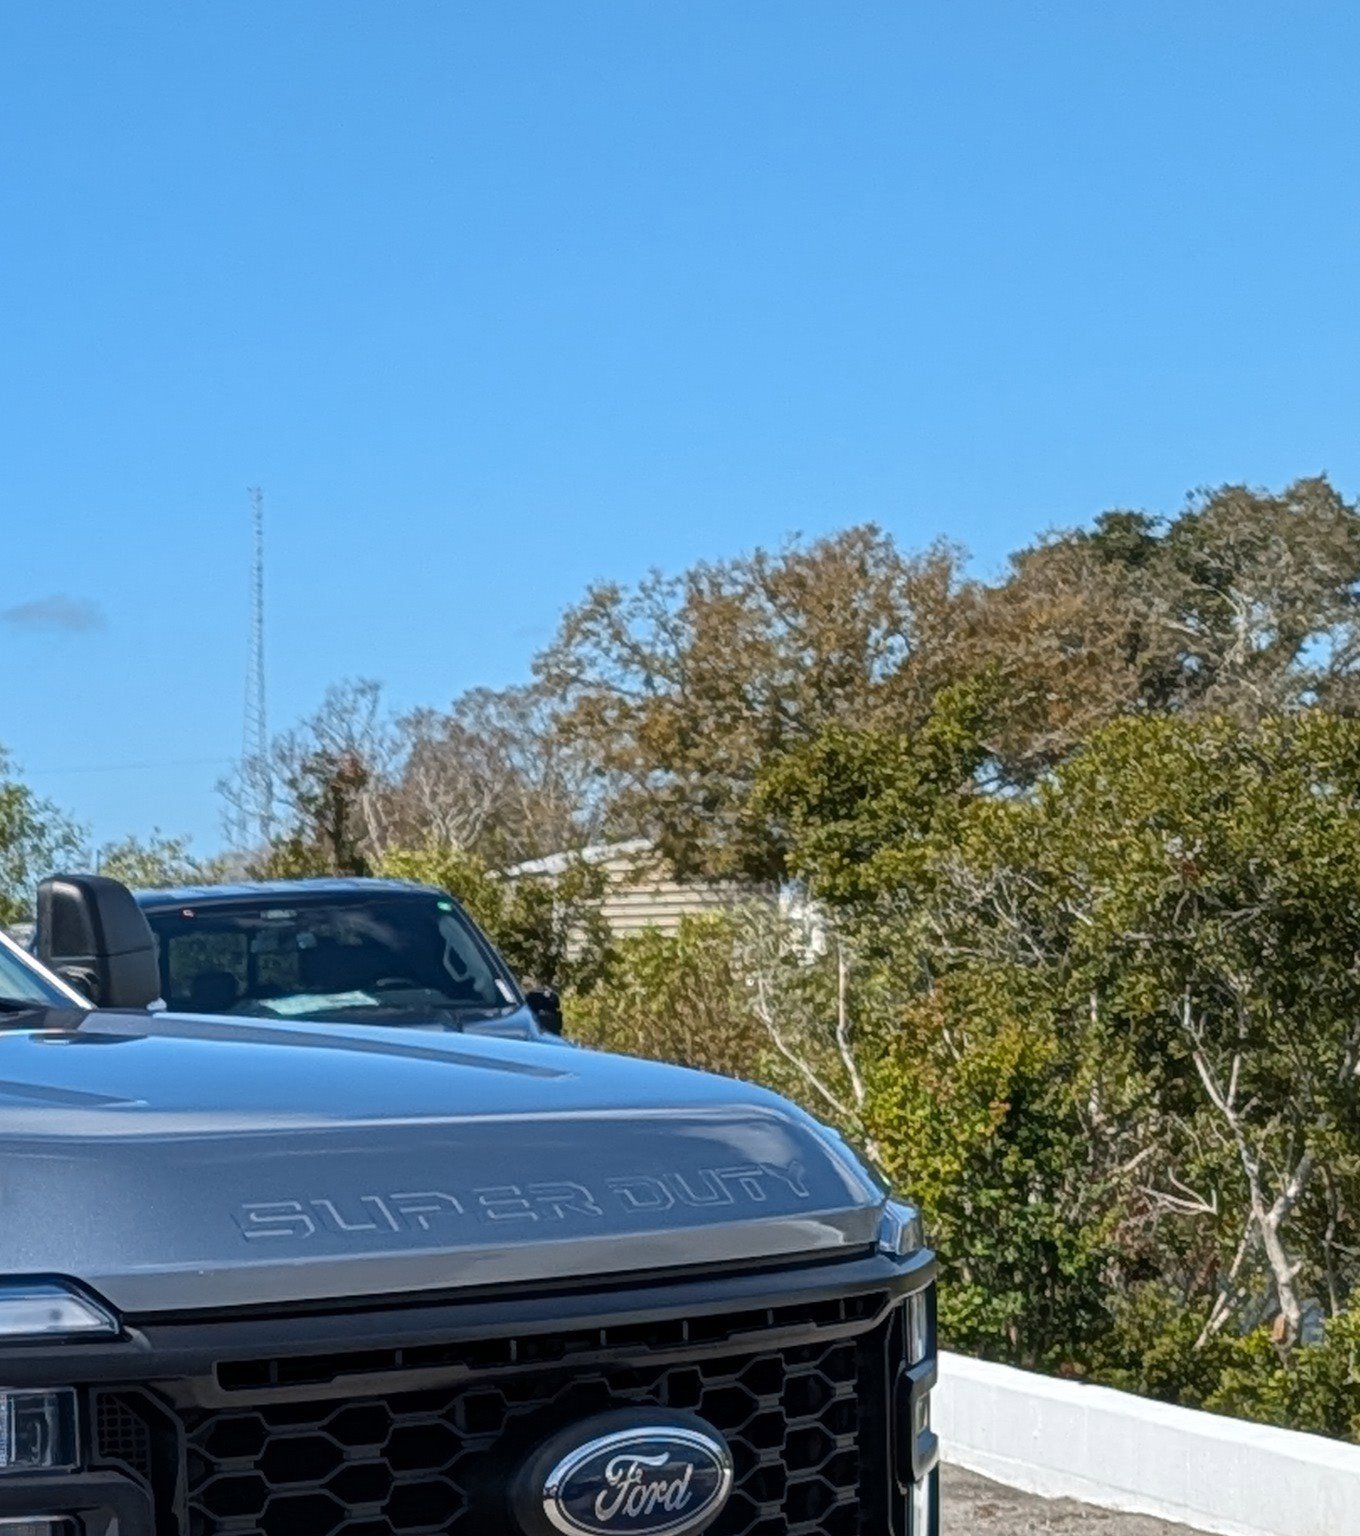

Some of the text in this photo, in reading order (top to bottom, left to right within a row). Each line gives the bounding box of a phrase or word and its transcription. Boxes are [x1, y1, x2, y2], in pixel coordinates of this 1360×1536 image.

[233, 1160, 810, 1240] SUPER DUTY
[593, 1451, 695, 1522] Ford
